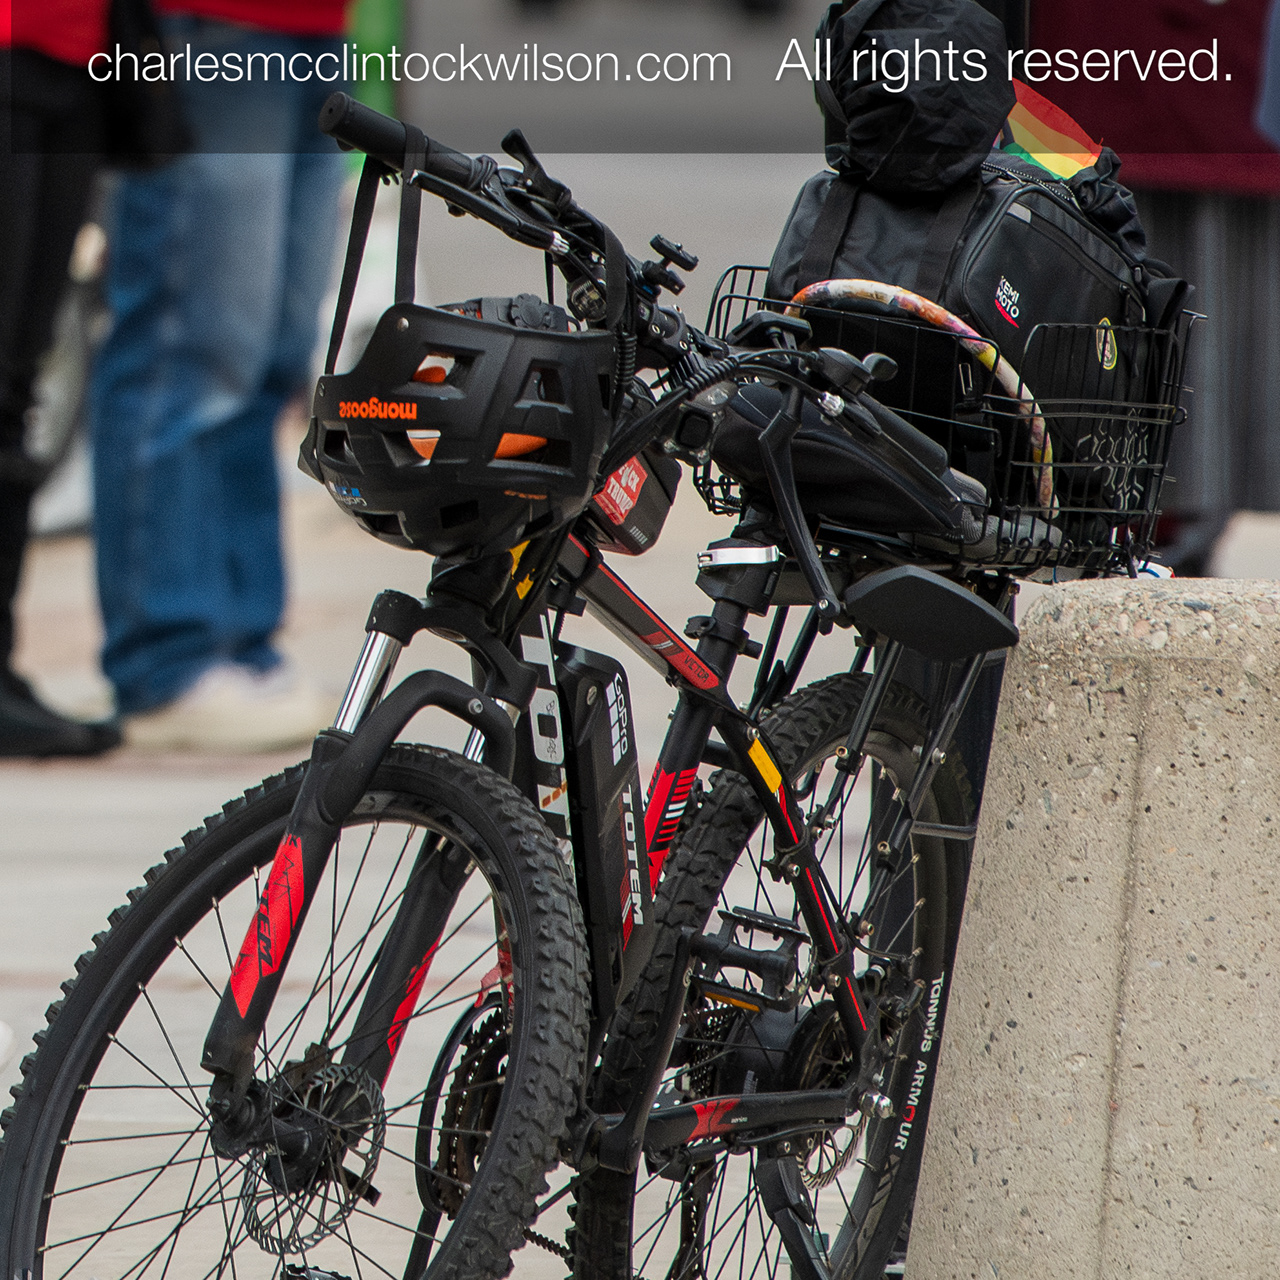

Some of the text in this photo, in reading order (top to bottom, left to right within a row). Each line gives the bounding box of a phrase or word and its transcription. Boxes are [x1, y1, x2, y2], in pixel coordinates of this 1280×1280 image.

[996, 287, 1020, 318] MOTO
[998, 276, 1020, 304] KEMI
[339, 397, 417, 420] mongoose
[607, 477, 634, 515] TRUMP
[613, 672, 628, 755] GoPro
[622, 783, 644, 925] TOTEM
[894, 1059, 928, 1151] ARMOUR
